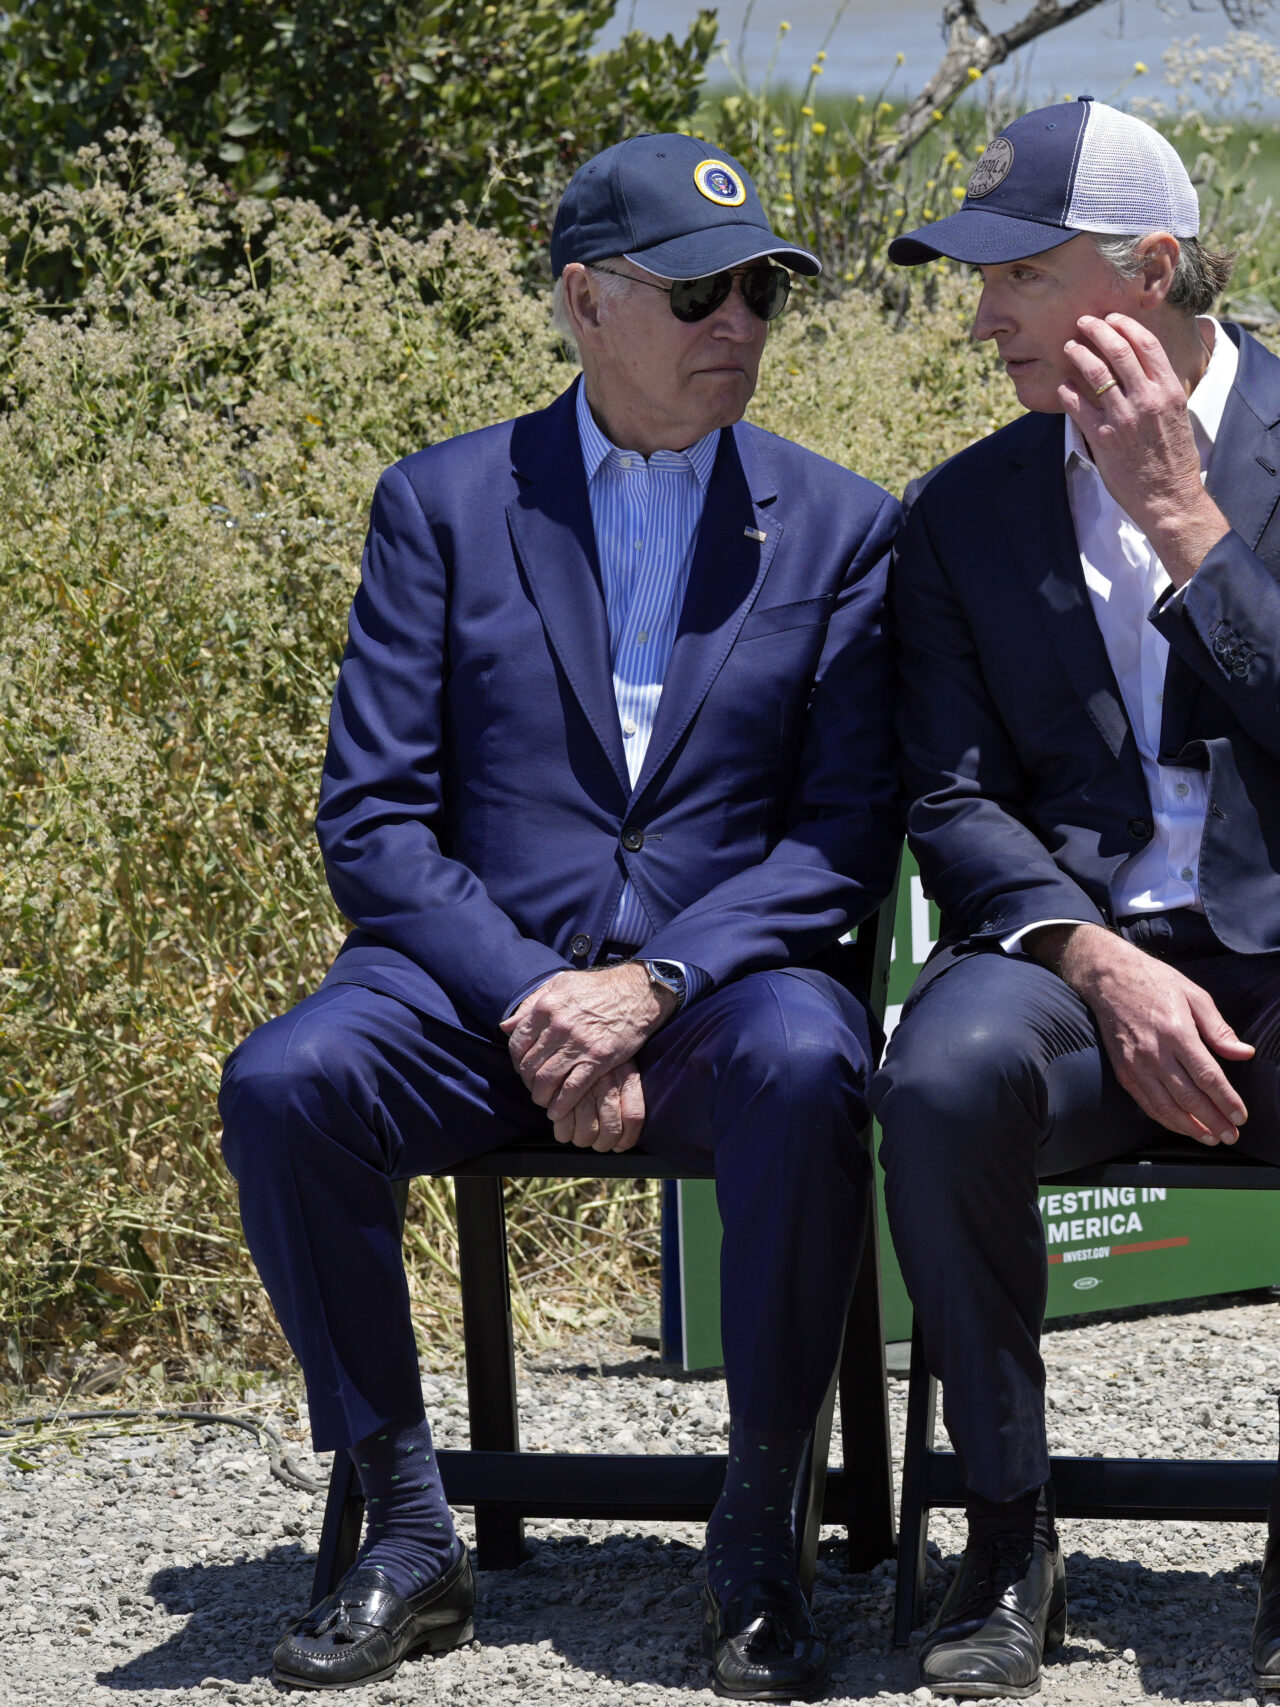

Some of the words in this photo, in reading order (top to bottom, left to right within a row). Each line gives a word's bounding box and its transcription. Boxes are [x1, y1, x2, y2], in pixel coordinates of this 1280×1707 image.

[975, 159, 1008, 175] APITOLA
[1038, 1187, 1136, 1216] VESTING
[1141, 1187, 1167, 1203] IN
[1046, 1211, 1143, 1244] MERICA
[1062, 1246, 1111, 1264] INVEST.GOV
